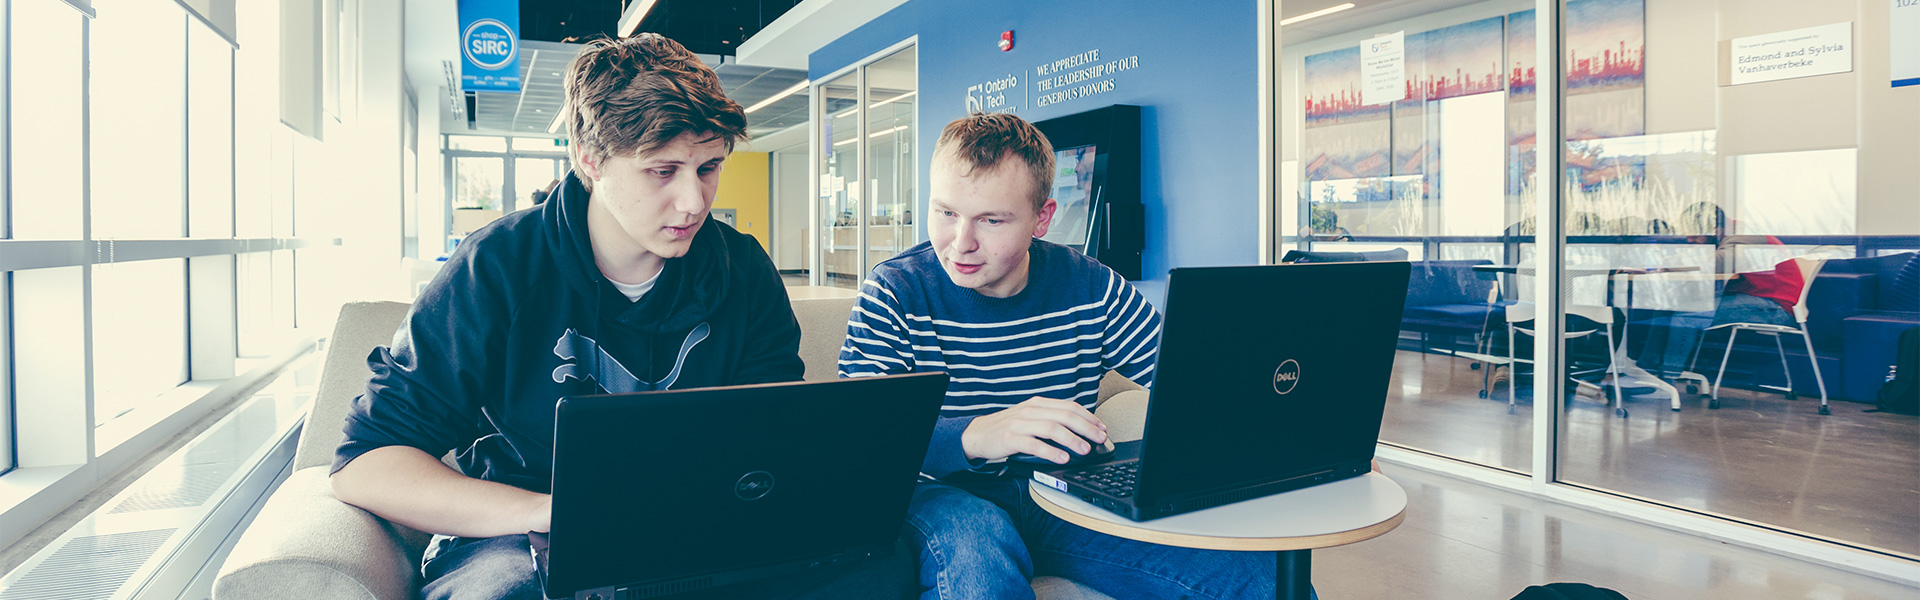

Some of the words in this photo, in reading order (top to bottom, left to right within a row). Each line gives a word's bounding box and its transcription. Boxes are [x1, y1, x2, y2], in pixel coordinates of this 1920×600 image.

[481, 31, 498, 39] shop
[472, 39, 508, 55] SIRC
[1738, 51, 1781, 64] Edmond
[1784, 48, 1805, 58] and
[1808, 44, 1844, 56] Sylvia
[1037, 64, 1049, 76] WE
[1050, 49, 1100, 73] APPRECIATE
[1738, 59, 1813, 73] Vanhaverbeke
[1037, 78, 1052, 92] THE
[1054, 64, 1104, 88] LEADERSHIP
[1105, 61, 1118, 75] OF
[1118, 55, 1139, 71] OUR
[985, 73, 1017, 94] Ontario
[1037, 87, 1078, 107] GENEROUS
[1079, 78, 1115, 98] DONORS
[986, 92, 1005, 108] Tech
[1276, 372, 1296, 382] DELL
